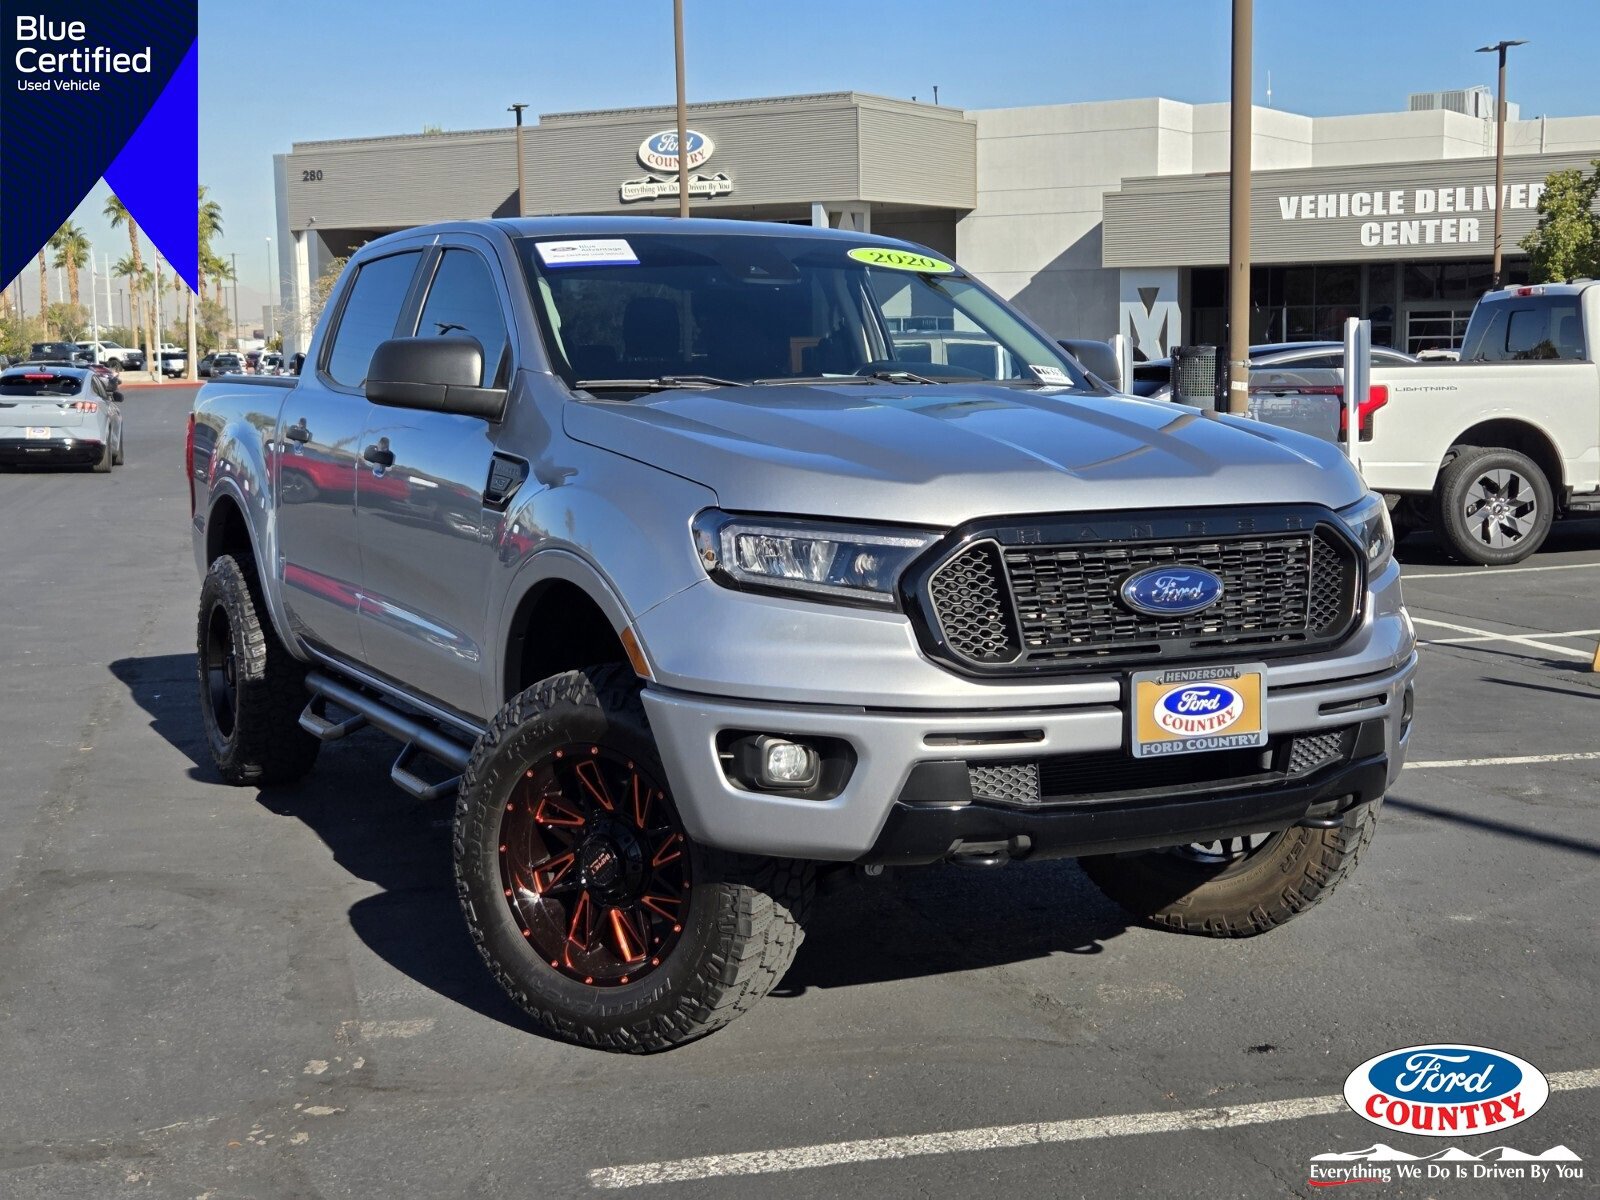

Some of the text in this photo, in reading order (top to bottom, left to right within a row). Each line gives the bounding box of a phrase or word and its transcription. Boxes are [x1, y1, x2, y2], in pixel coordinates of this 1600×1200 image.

[647, 149, 706, 168] COUNRY
[302, 169, 323, 182] 280
[624, 185, 656, 195] Everything
[1279, 183, 1546, 220] VEHICLE DELIVER
[1360, 218, 1480, 247] CENTER
[870, 251, 936, 268] 2020
[1151, 575, 1205, 602] Ford
[1165, 667, 1233, 682] HENDERSON
[1177, 690, 1221, 713] Ford
[1162, 706, 1236, 733] COUNTRY
[1142, 733, 1259, 755] FORD COUNTRY
